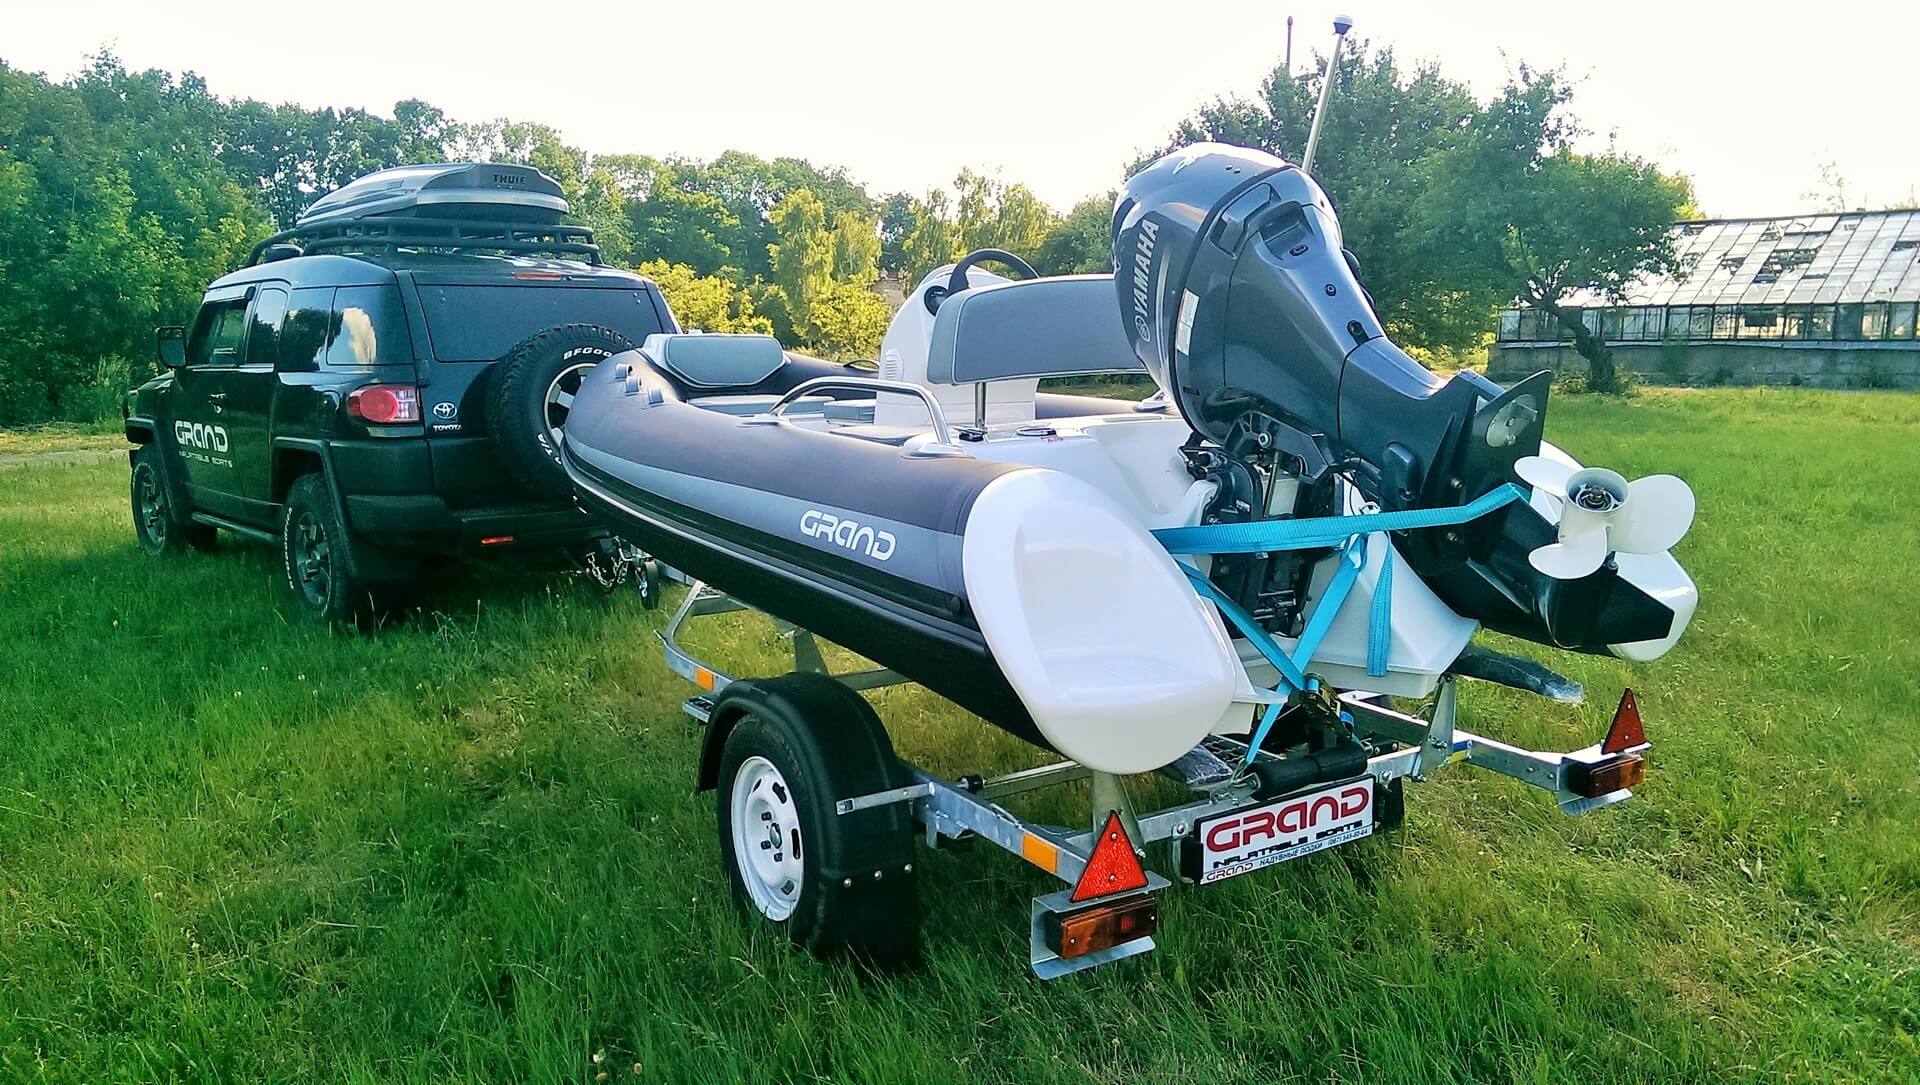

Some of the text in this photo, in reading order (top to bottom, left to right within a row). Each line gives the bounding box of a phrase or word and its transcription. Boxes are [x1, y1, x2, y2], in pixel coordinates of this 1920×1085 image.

[1133, 219, 1159, 317] YAMAHA
[175, 420, 229, 453] GRAND
[432, 424, 462, 432] TOYOTA
[800, 509, 896, 561] GRAND
[1206, 786, 1370, 853] GRAND
[1213, 819, 1363, 869] INFLATABLE BOATS
[1206, 862, 1253, 881] GRAND
